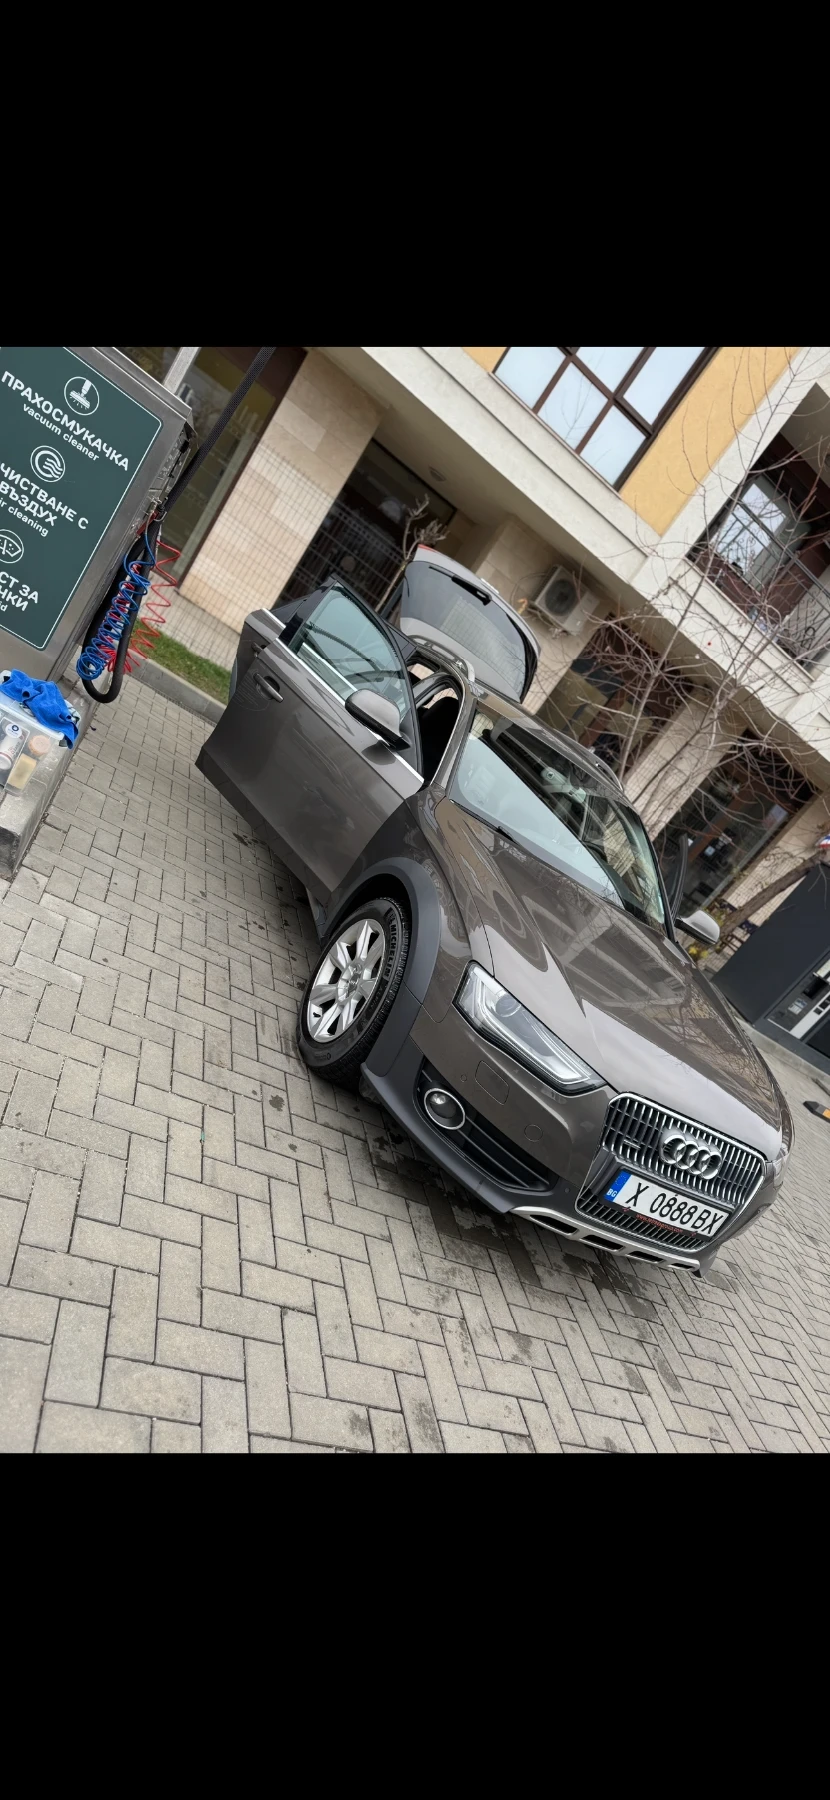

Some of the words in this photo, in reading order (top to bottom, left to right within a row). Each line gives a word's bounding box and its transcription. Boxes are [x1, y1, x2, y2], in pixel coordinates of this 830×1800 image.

[1, 370, 129, 471] ПРАХОСМУКАЧКА
[23, 403, 62, 435] vacuum
[62, 433, 100, 461] cleaner
[0, 480, 58, 526] ВЪЗДУХ
[7, 505, 49, 537] cleaning
[18, 584, 39, 604] ЗА
[382, 923, 397, 978] MICHELIN
[606, 1188, 618, 1198] BG
[625, 1182, 650, 1208] X
